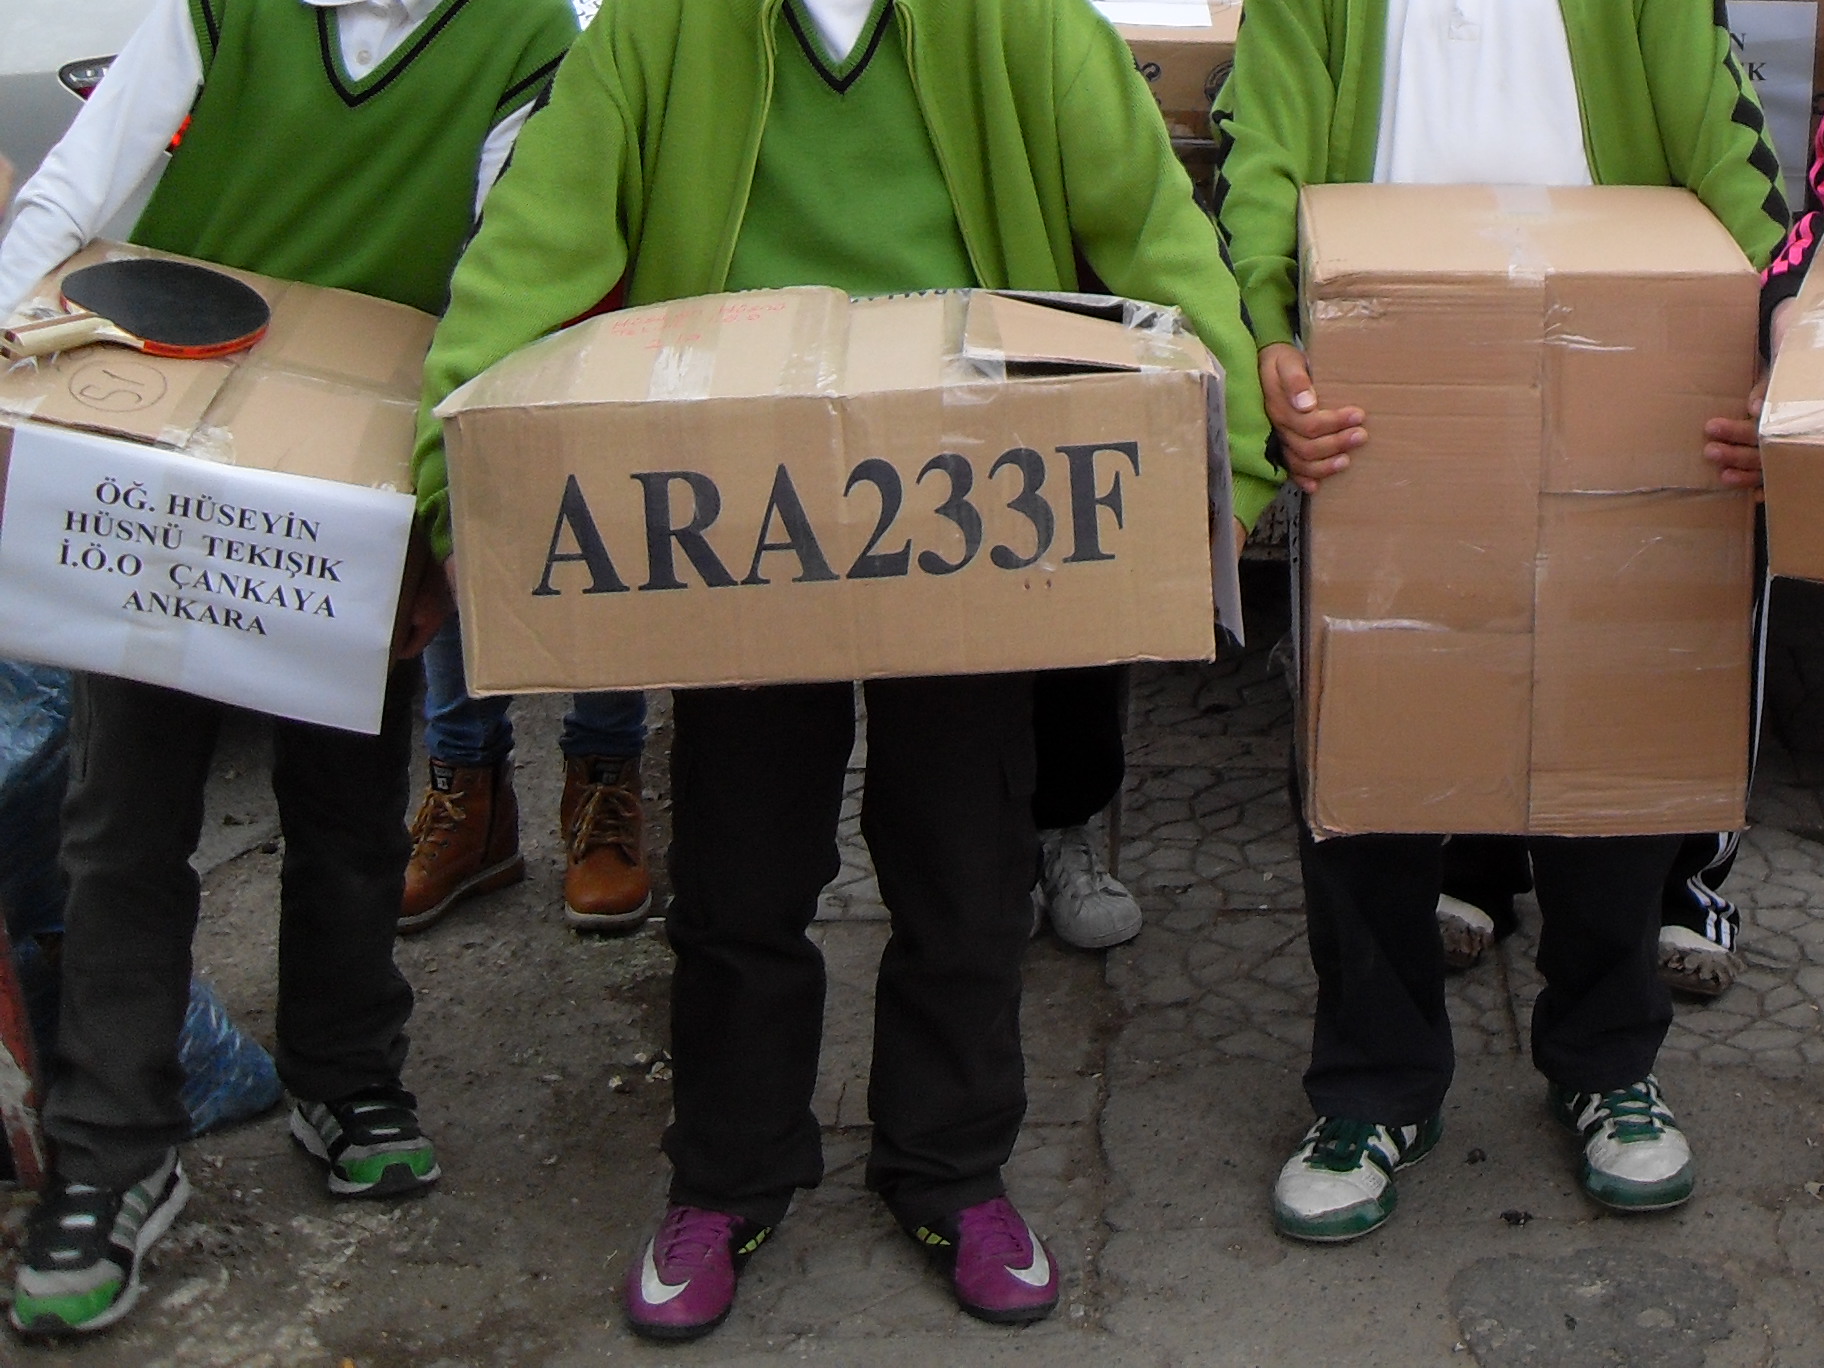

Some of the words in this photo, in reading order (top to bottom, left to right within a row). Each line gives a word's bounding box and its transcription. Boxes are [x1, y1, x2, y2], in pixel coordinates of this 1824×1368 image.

[63, 508, 184, 551] HÜSNÜ
[202, 534, 345, 583] TEKIŞIK
[95, 475, 156, 513] ÖĞ.
[166, 492, 322, 543] HÜSEYİN
[531, 440, 1142, 597] ARA233F
[57, 537, 143, 578] İ.Ö.O
[168, 562, 337, 620] ÇANKAYA
[121, 589, 268, 637] ANKARA
